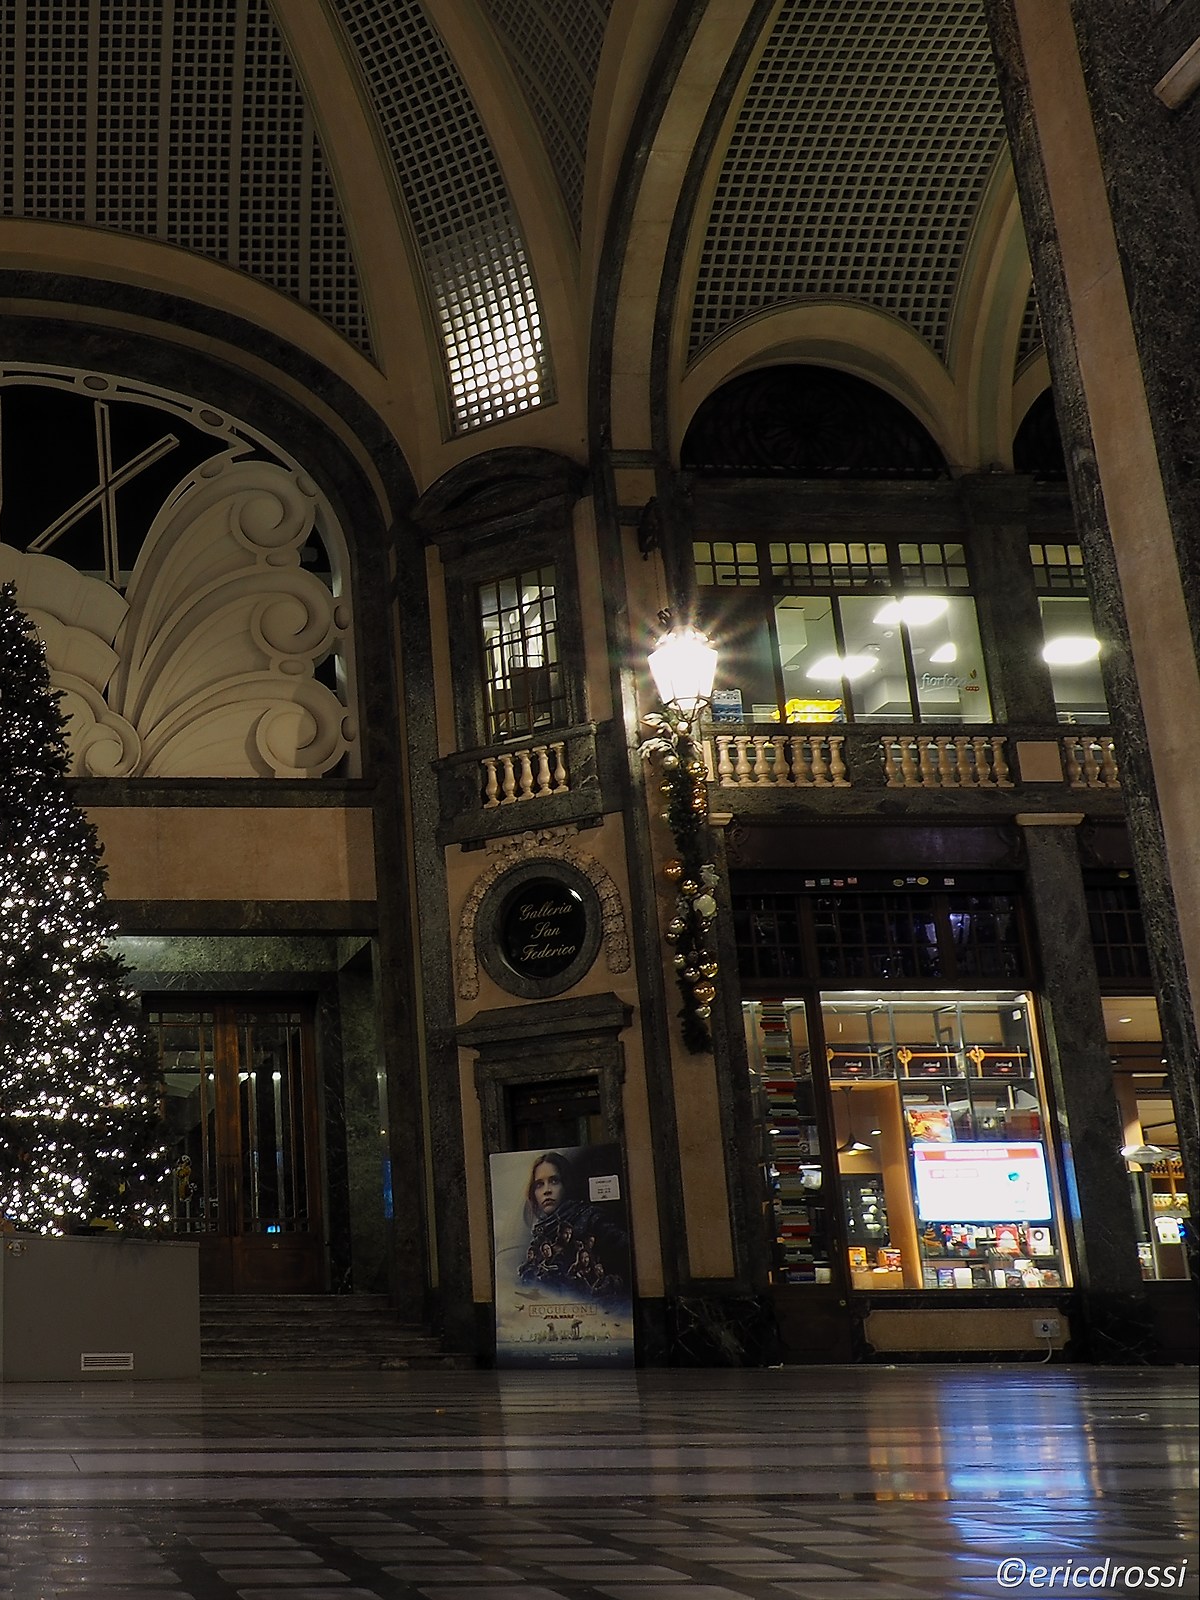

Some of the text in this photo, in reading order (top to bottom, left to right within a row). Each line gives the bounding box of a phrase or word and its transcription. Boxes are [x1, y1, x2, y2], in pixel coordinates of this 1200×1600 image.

[519, 900, 573, 921] Galleria
[530, 921, 561, 940] San
[520, 943, 576, 962] Federico
[531, 1304, 594, 1315] ROGUE ONE
